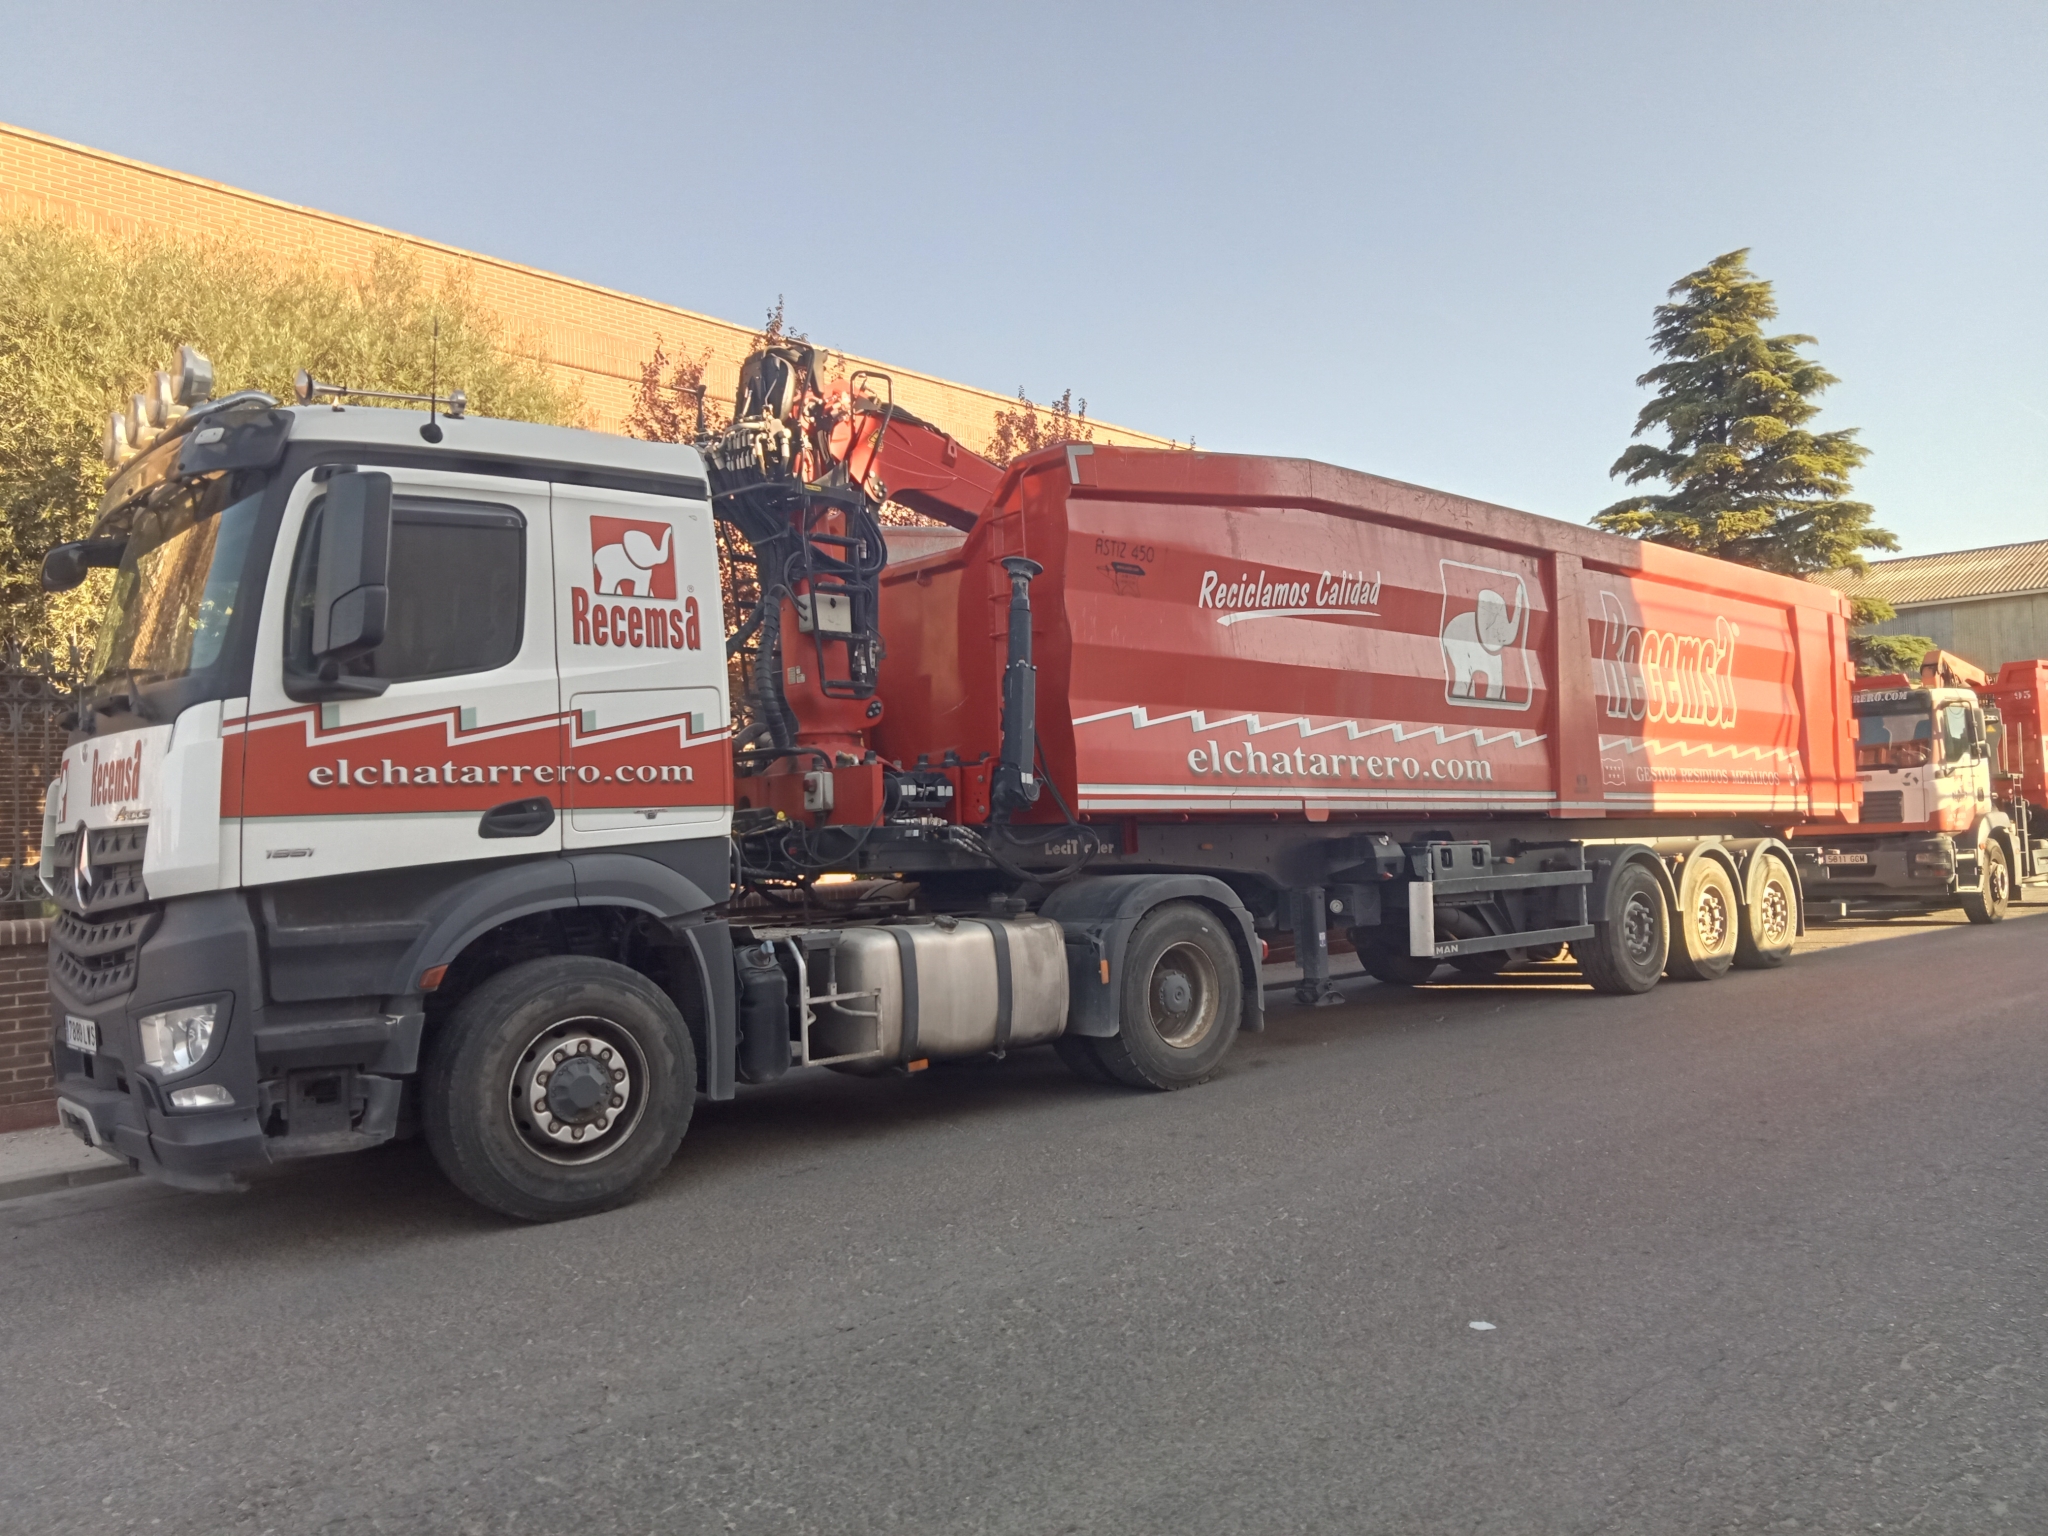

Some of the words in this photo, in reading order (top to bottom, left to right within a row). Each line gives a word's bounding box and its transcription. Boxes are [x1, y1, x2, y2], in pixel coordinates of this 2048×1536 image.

[1131, 544, 1155, 563] 450
[1198, 569, 1310, 609] Reciclamos
[1315, 569, 1381, 607] Calidad
[571, 586, 702, 651] Recemsa
[1599, 590, 1738, 730] Recemsa
[1851, 691, 1908, 704] RERO.COM
[2013, 690, 2031, 700] 95
[90, 739, 142, 808] Recemsa
[307, 758, 696, 787] elchatarrero.com
[1187, 740, 1493, 781] elchatarrero.com
[1636, 766, 1677, 782] GESTOR
[1679, 767, 1729, 784] RESIDUOS
[1732, 768, 1780, 785] METÁLICOS
[1436, 944, 1459, 955] MAN
